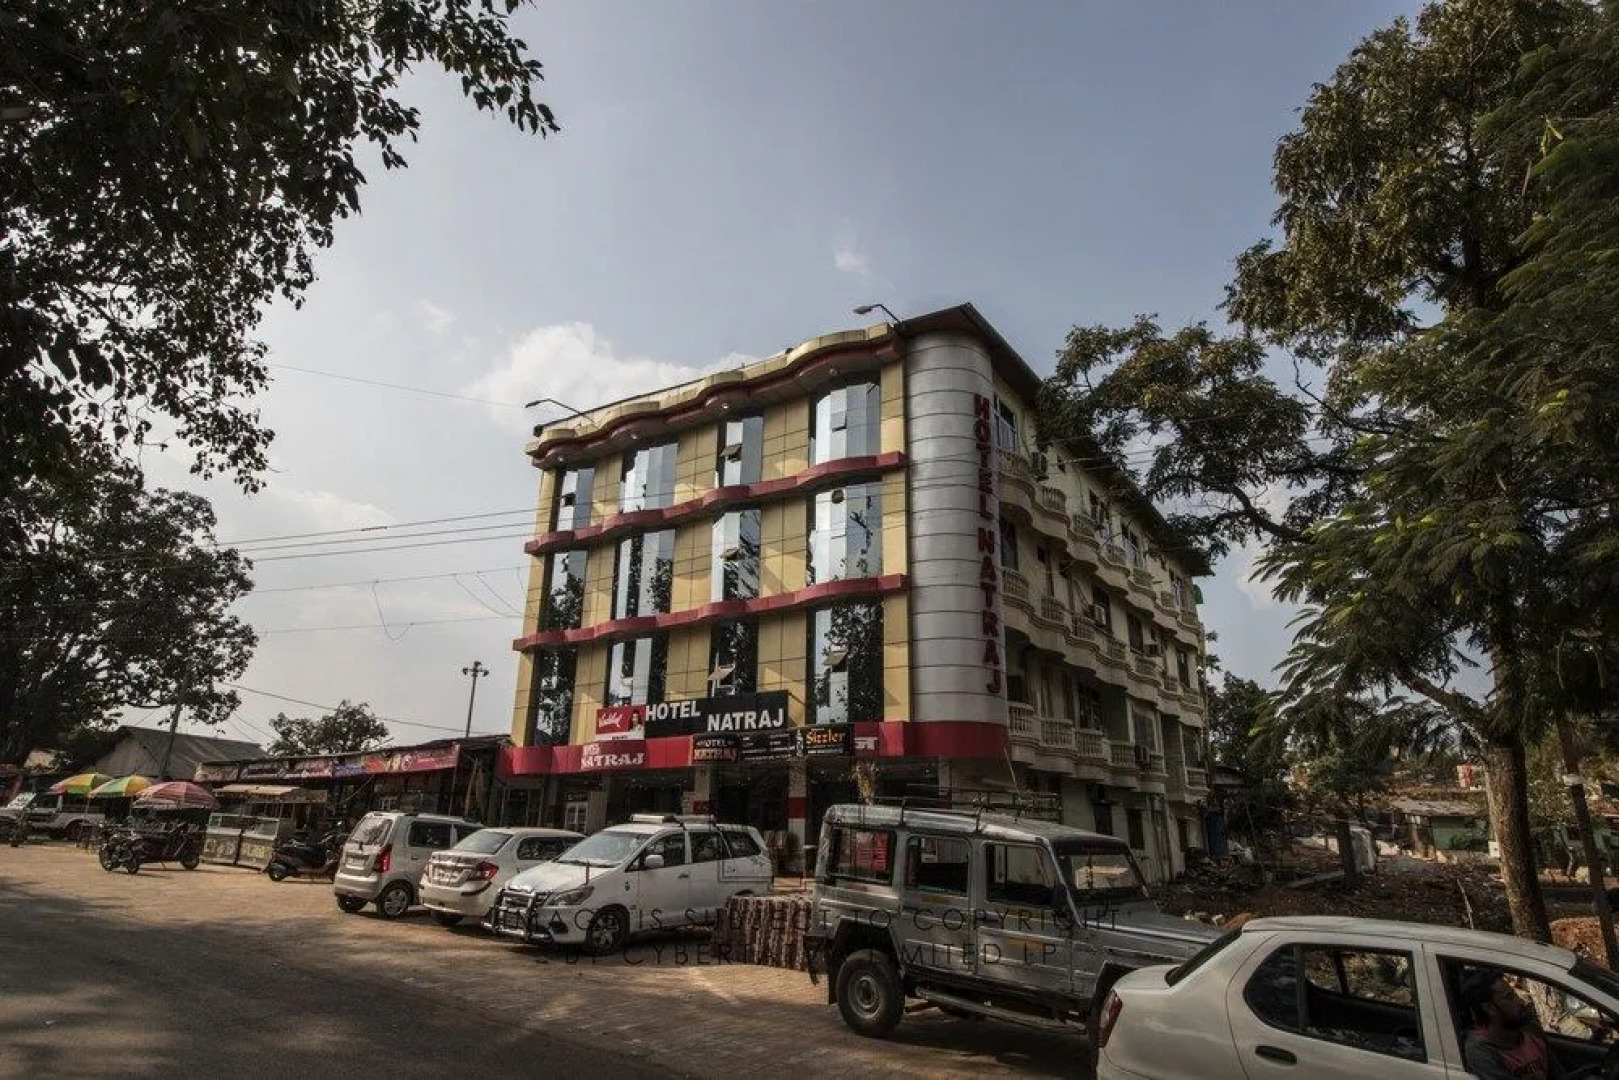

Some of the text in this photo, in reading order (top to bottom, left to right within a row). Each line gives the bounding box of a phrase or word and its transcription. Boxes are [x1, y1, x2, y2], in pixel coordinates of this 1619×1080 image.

[978, 528, 1000, 695] NATRAJ
[645, 700, 702, 721] HOTEL
[706, 708, 785, 732] NATRAJ
